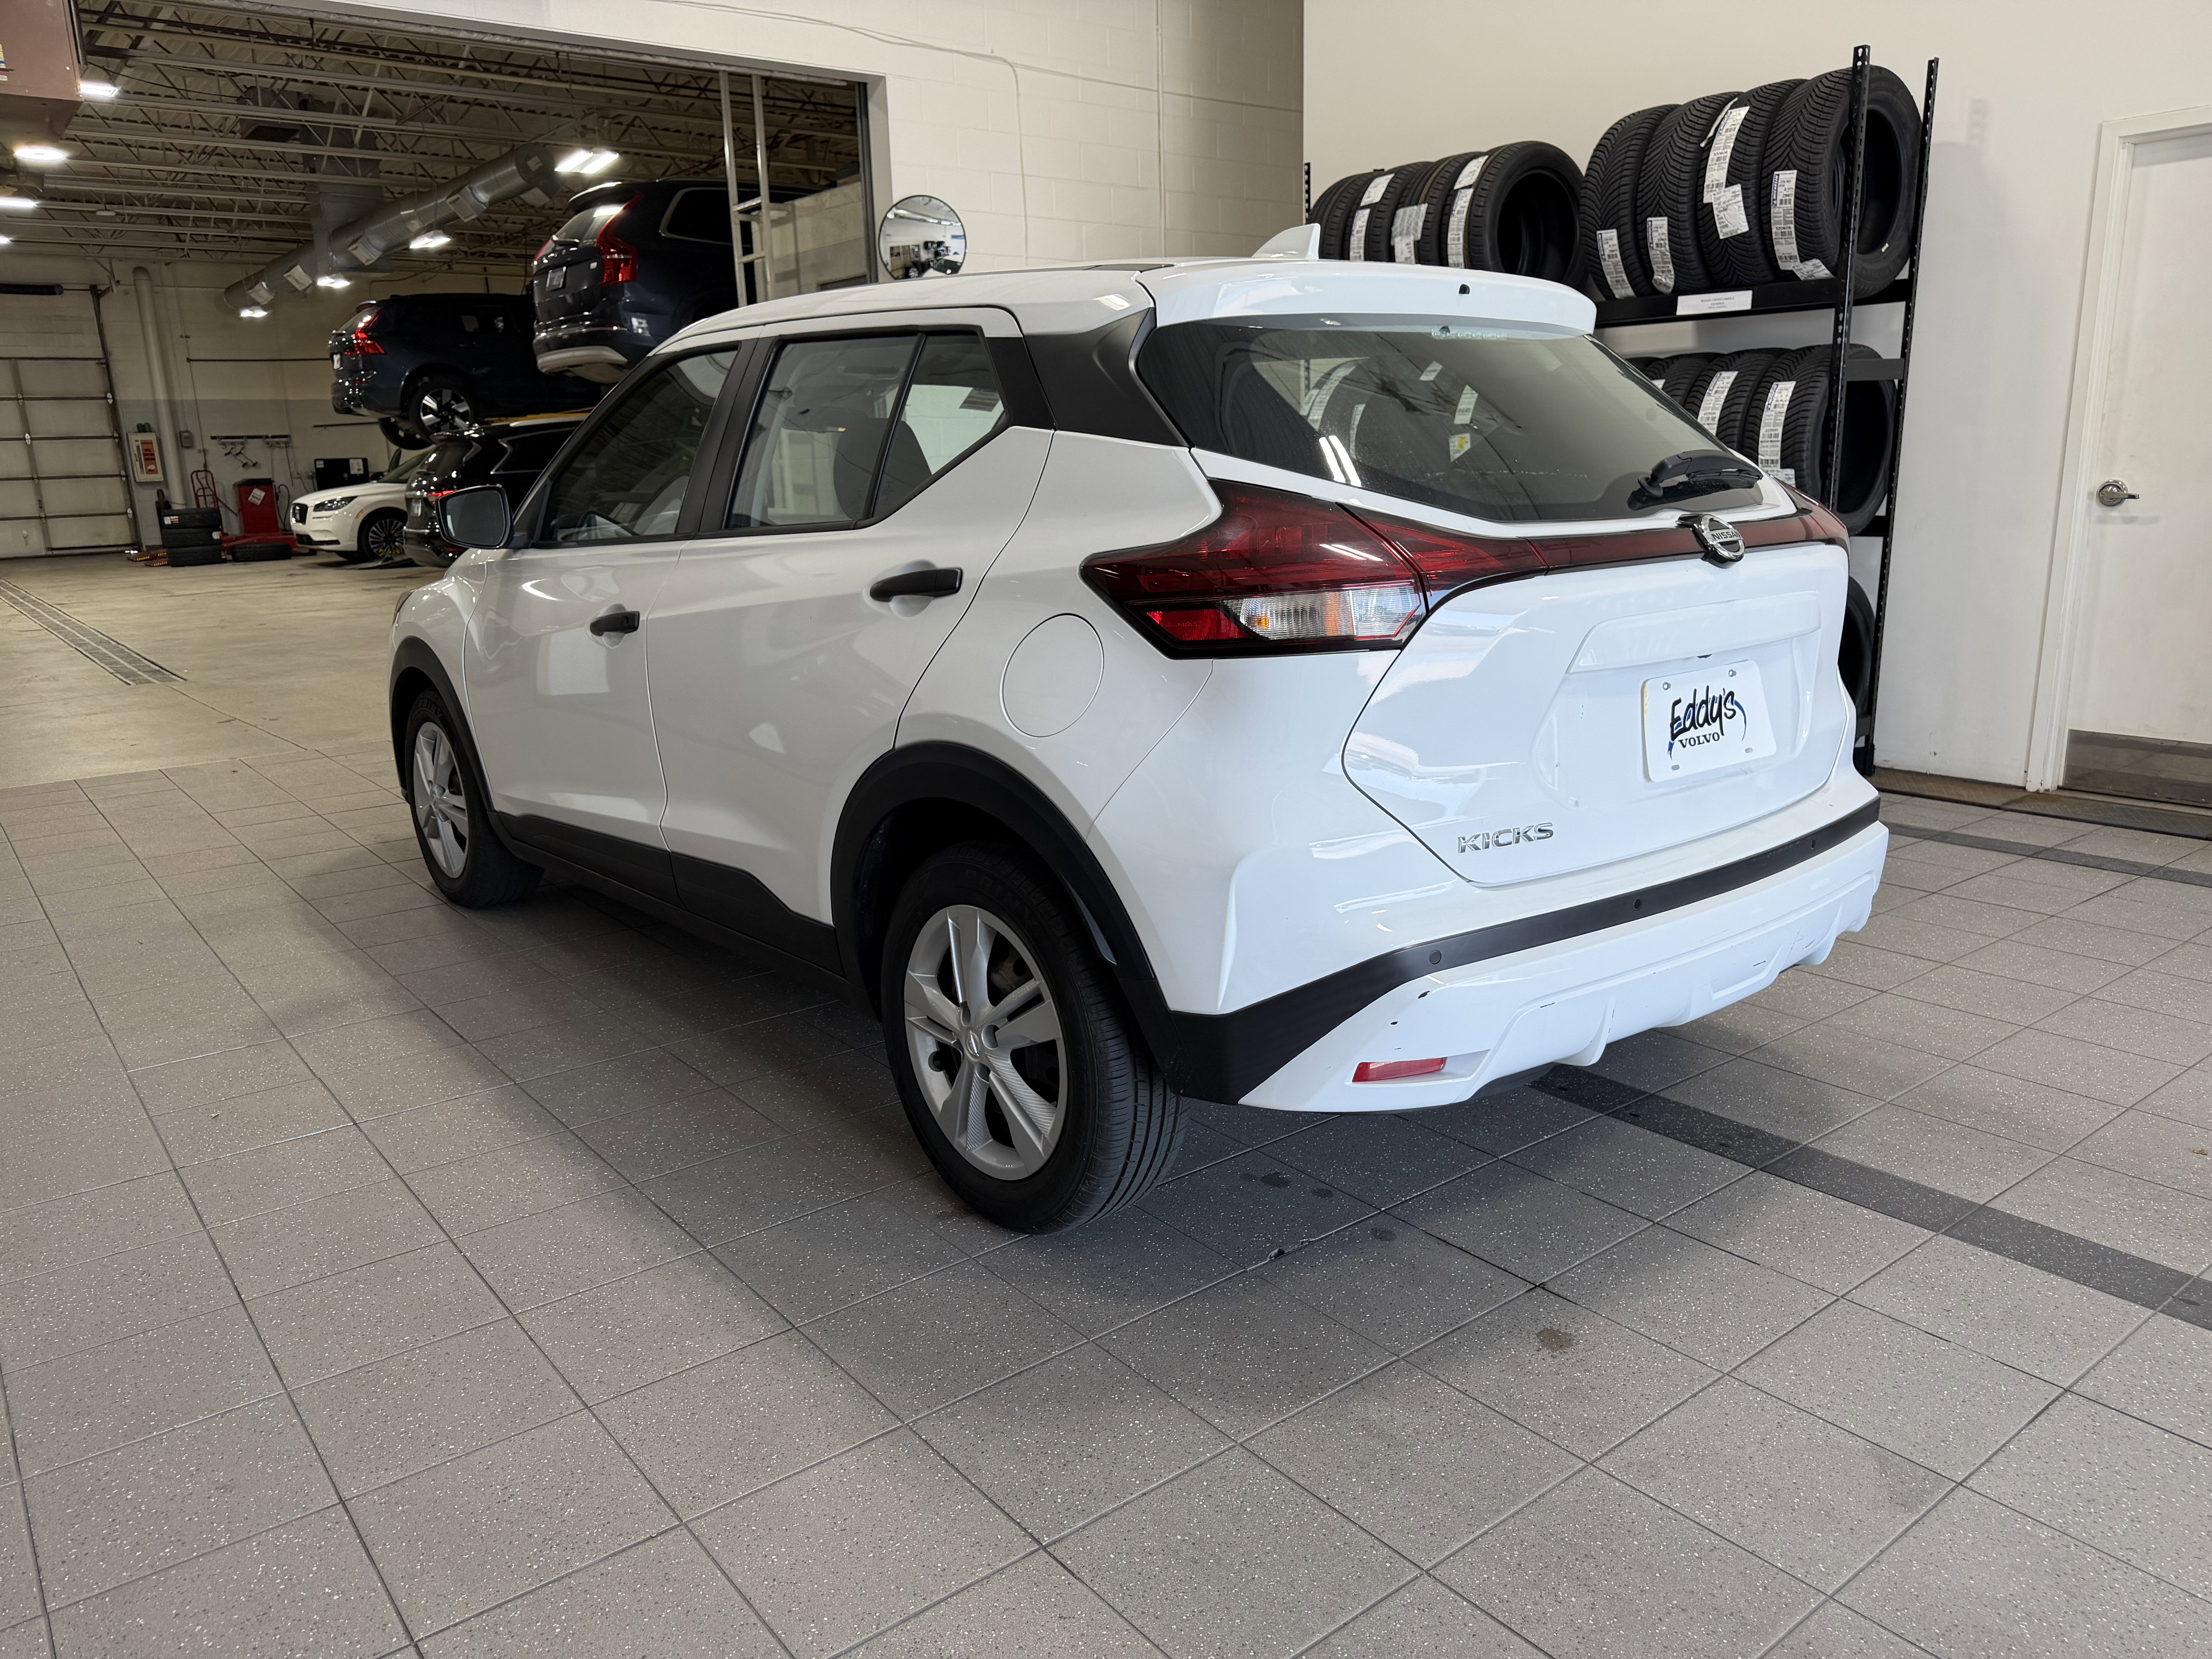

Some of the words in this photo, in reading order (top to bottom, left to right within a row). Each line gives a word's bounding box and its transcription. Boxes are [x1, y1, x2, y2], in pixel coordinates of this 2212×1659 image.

[1670, 685, 1736, 742] Eddy's
[1678, 732, 1720, 748] VOLVO
[1458, 822, 1554, 853] KICKS
